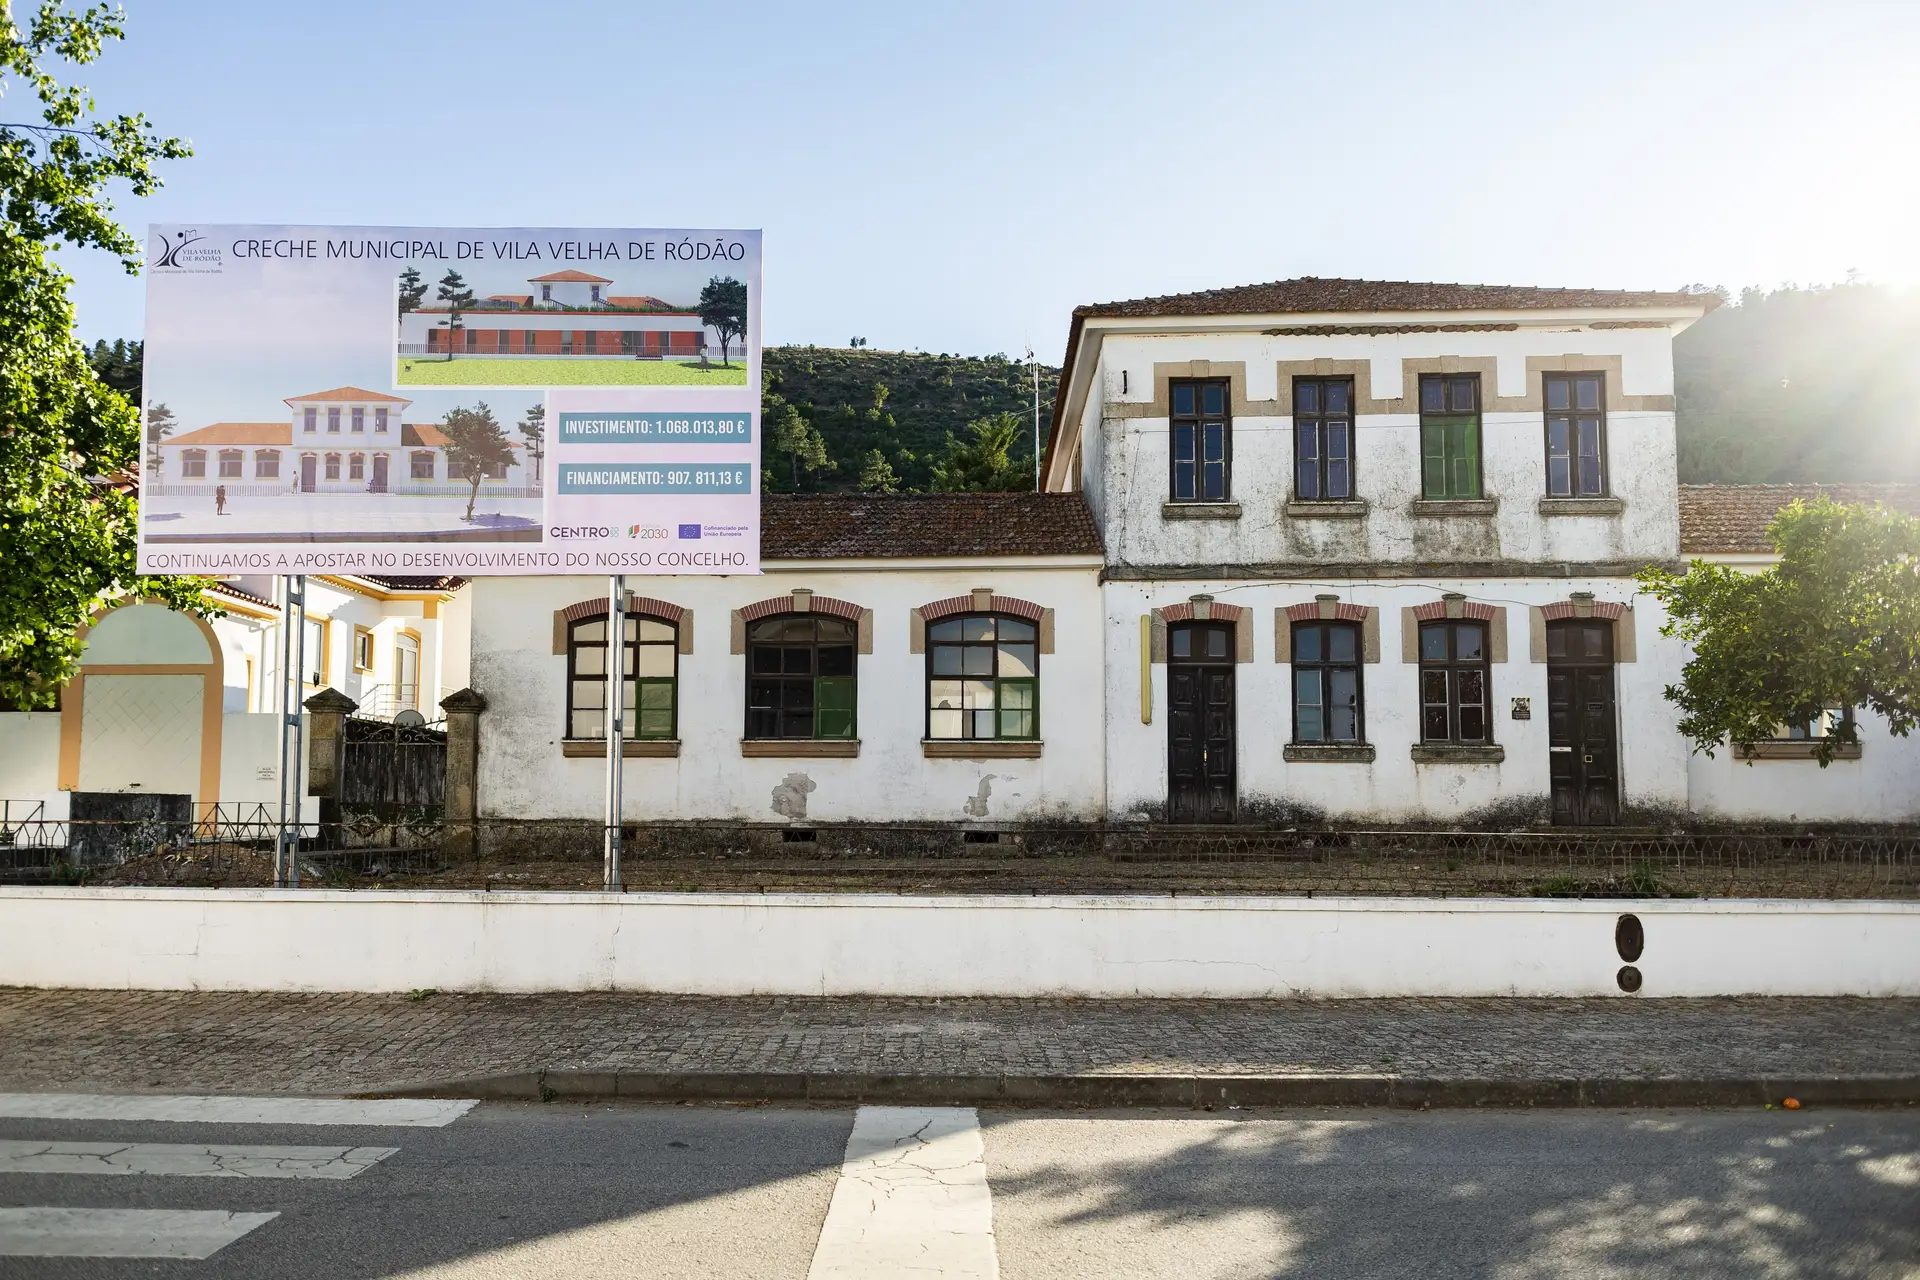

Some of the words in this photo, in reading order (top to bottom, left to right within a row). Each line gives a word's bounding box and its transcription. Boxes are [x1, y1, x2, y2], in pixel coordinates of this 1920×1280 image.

[232, 239, 318, 259] CRECHE
[326, 239, 450, 260] MUNICIPAL
[458, 241, 484, 260] DE
[492, 241, 542, 260] VILA
[548, 241, 621, 260] VELHA
[630, 241, 656, 261] DE
[664, 237, 746, 261] RÓDÃO
[565, 420, 653, 434] INVESTIMENTO:
[655, 420, 734, 436] 1.068.013,80
[737, 420, 745, 434] €
[566, 471, 664, 485] FINANCIAMENTO:
[667, 471, 692, 485] 907.
[695, 471, 732, 487] 811,13
[735, 471, 743, 485] €
[550, 526, 609, 538] CENTRO
[640, 528, 669, 539] 2030
[146, 553, 271, 569] CONTINUAMOS
[276, 553, 289, 568] A
[293, 553, 366, 568] APOSTAR
[371, 553, 397, 567] NO
[402, 552, 560, 567] DESENVOLVIMENTO
[566, 552, 590, 567] DO
[596, 552, 652, 567] NOSSO
[657, 552, 749, 567] CONCELHO.
